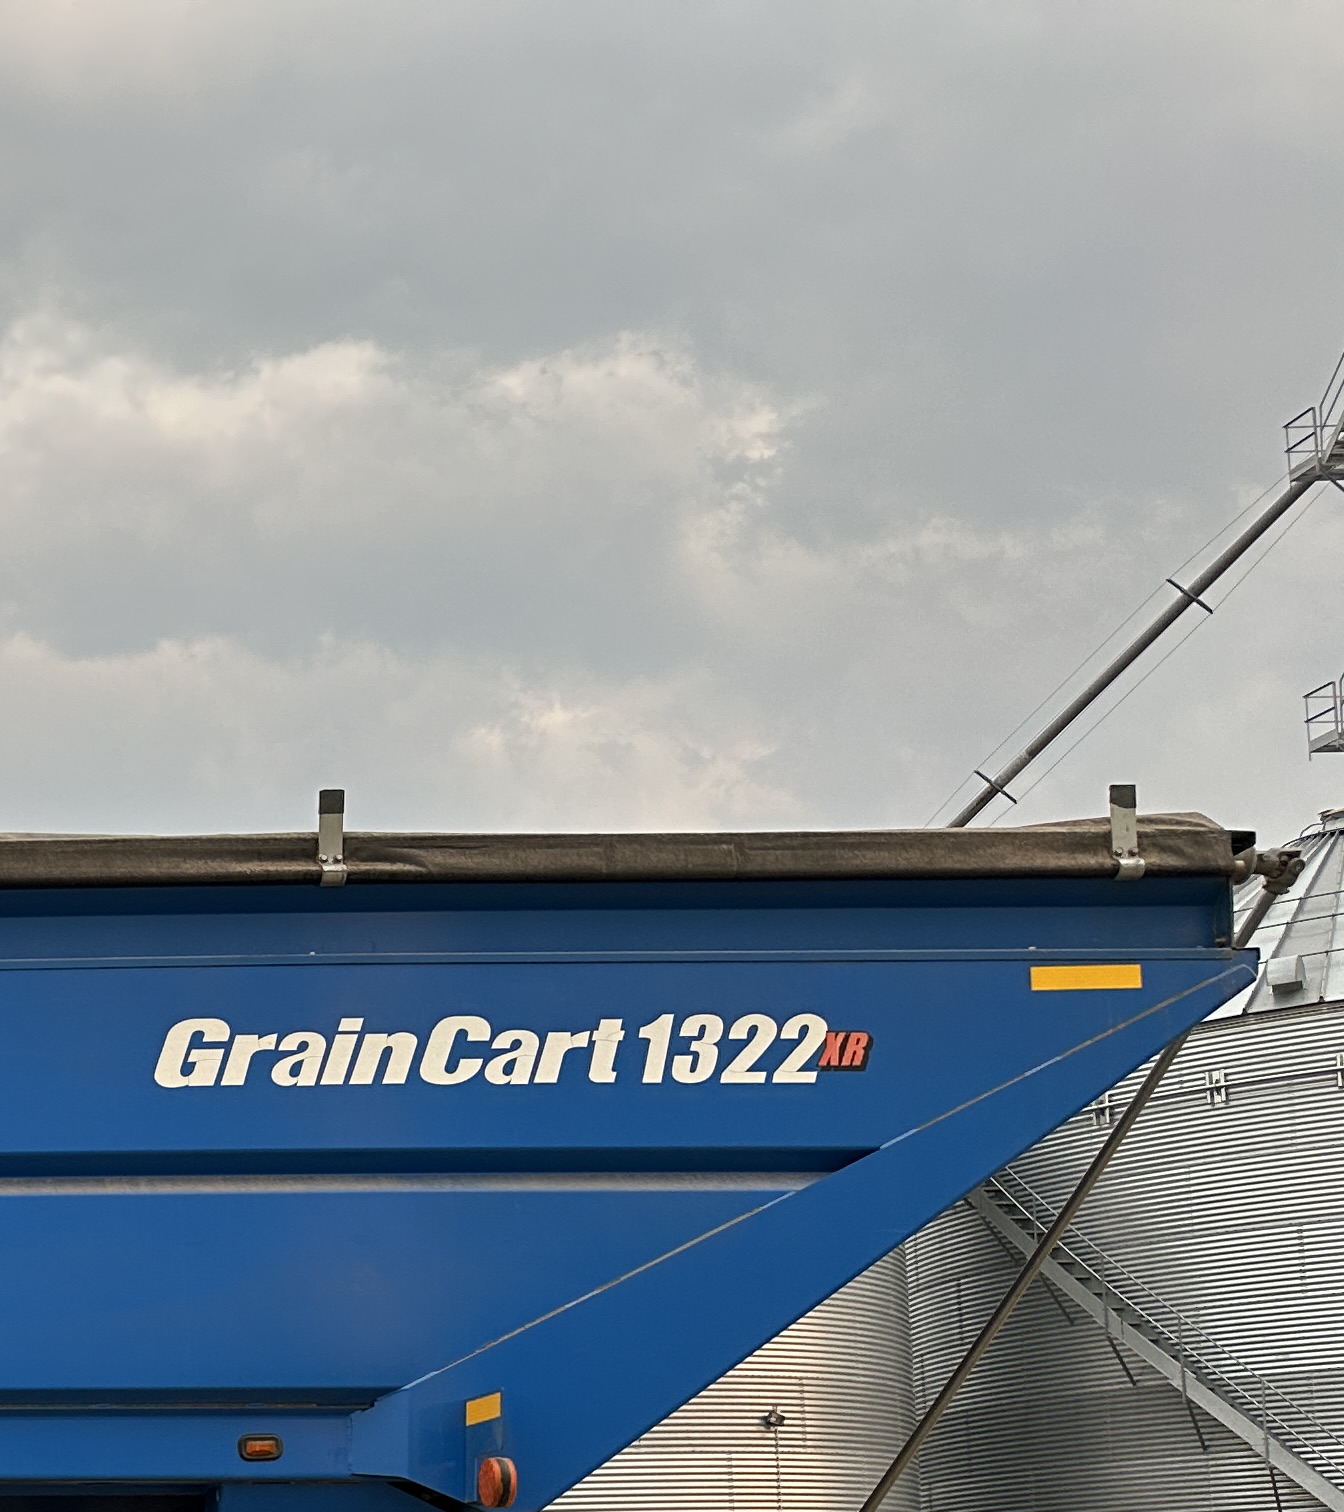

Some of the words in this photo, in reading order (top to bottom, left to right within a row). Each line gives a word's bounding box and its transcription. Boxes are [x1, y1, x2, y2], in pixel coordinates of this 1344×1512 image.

[153, 1016, 626, 1088] GrainCart
[638, 1013, 829, 1084] 1322
[817, 1031, 872, 1069] XR
